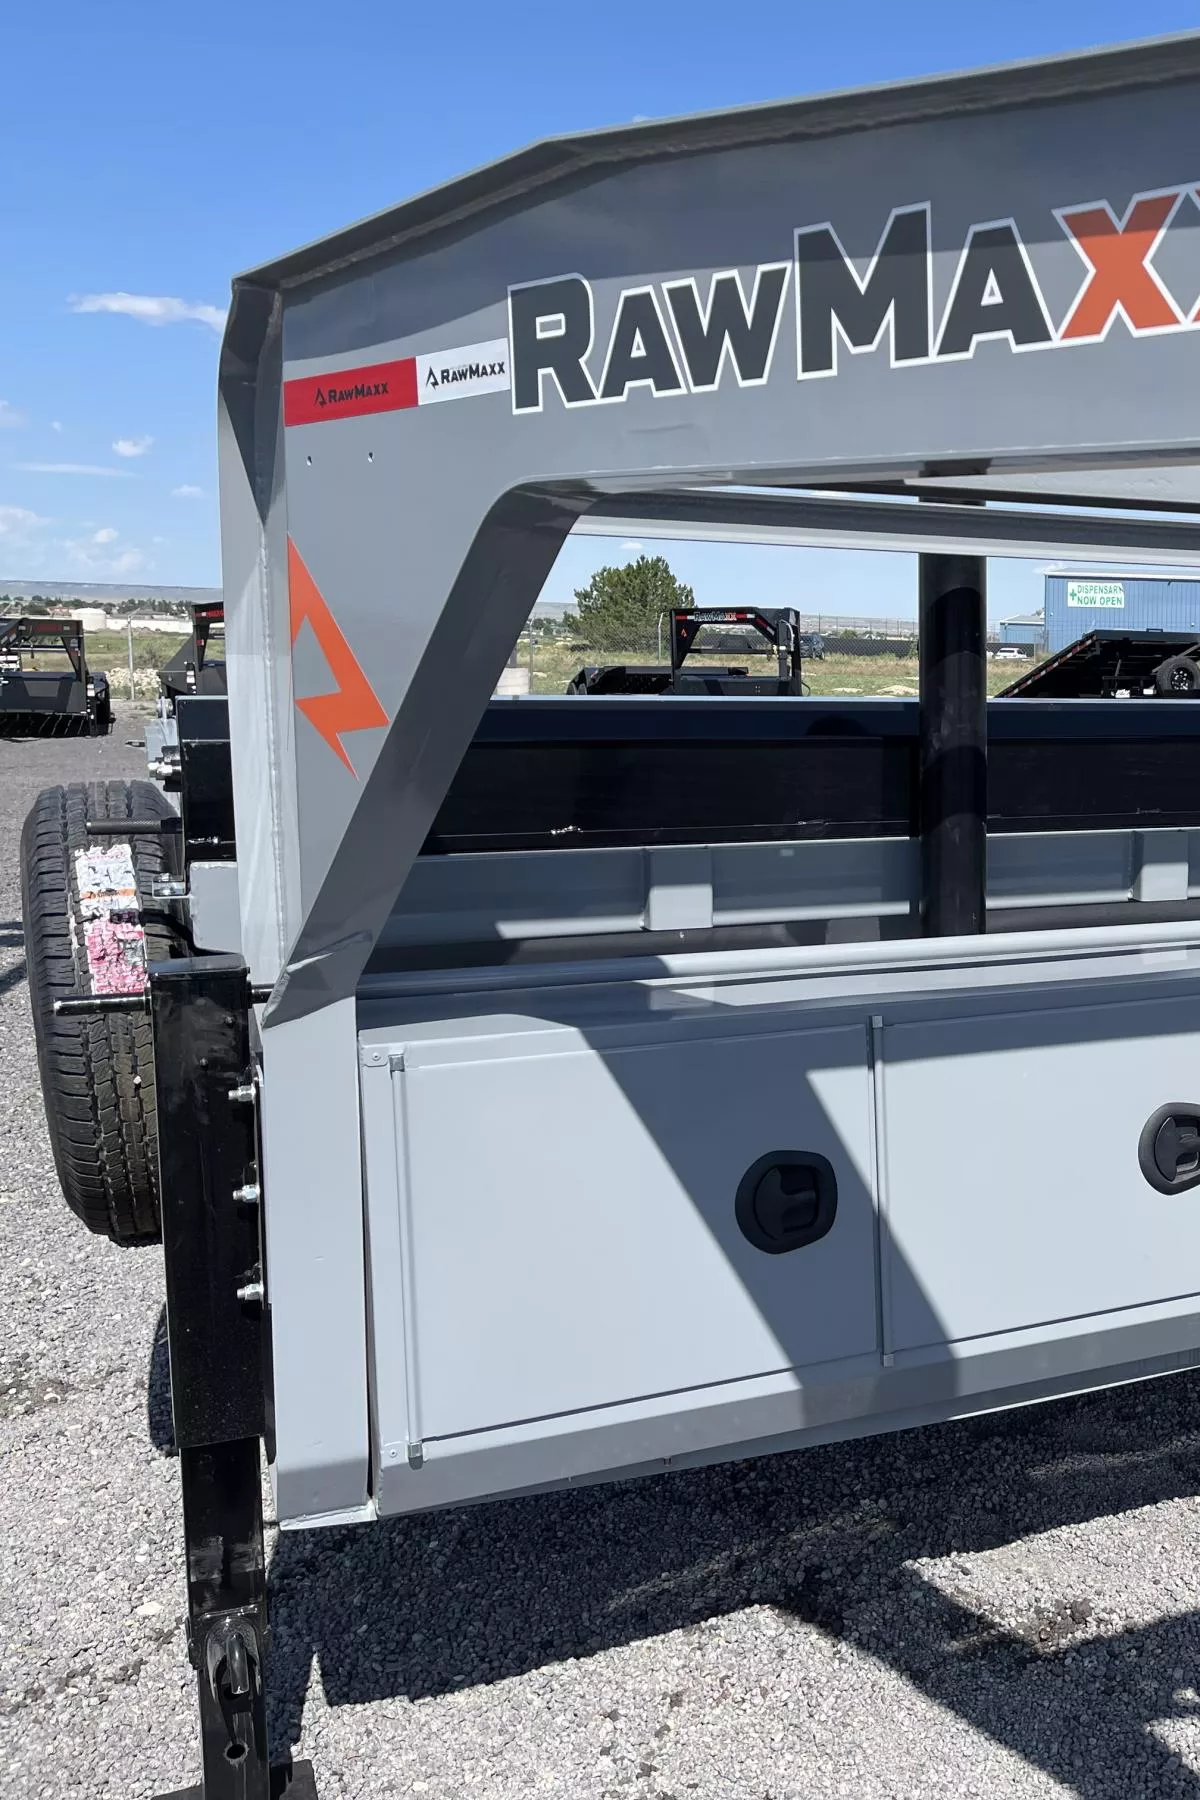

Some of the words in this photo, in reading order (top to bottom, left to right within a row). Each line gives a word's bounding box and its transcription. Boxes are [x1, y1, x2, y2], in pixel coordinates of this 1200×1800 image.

[440, 361, 506, 385] RAWMAXX
[327, 382, 389, 404] RAWMAXX
[1077, 596, 1097, 605] NOW
[1099, 596, 1122, 606] OPEN
